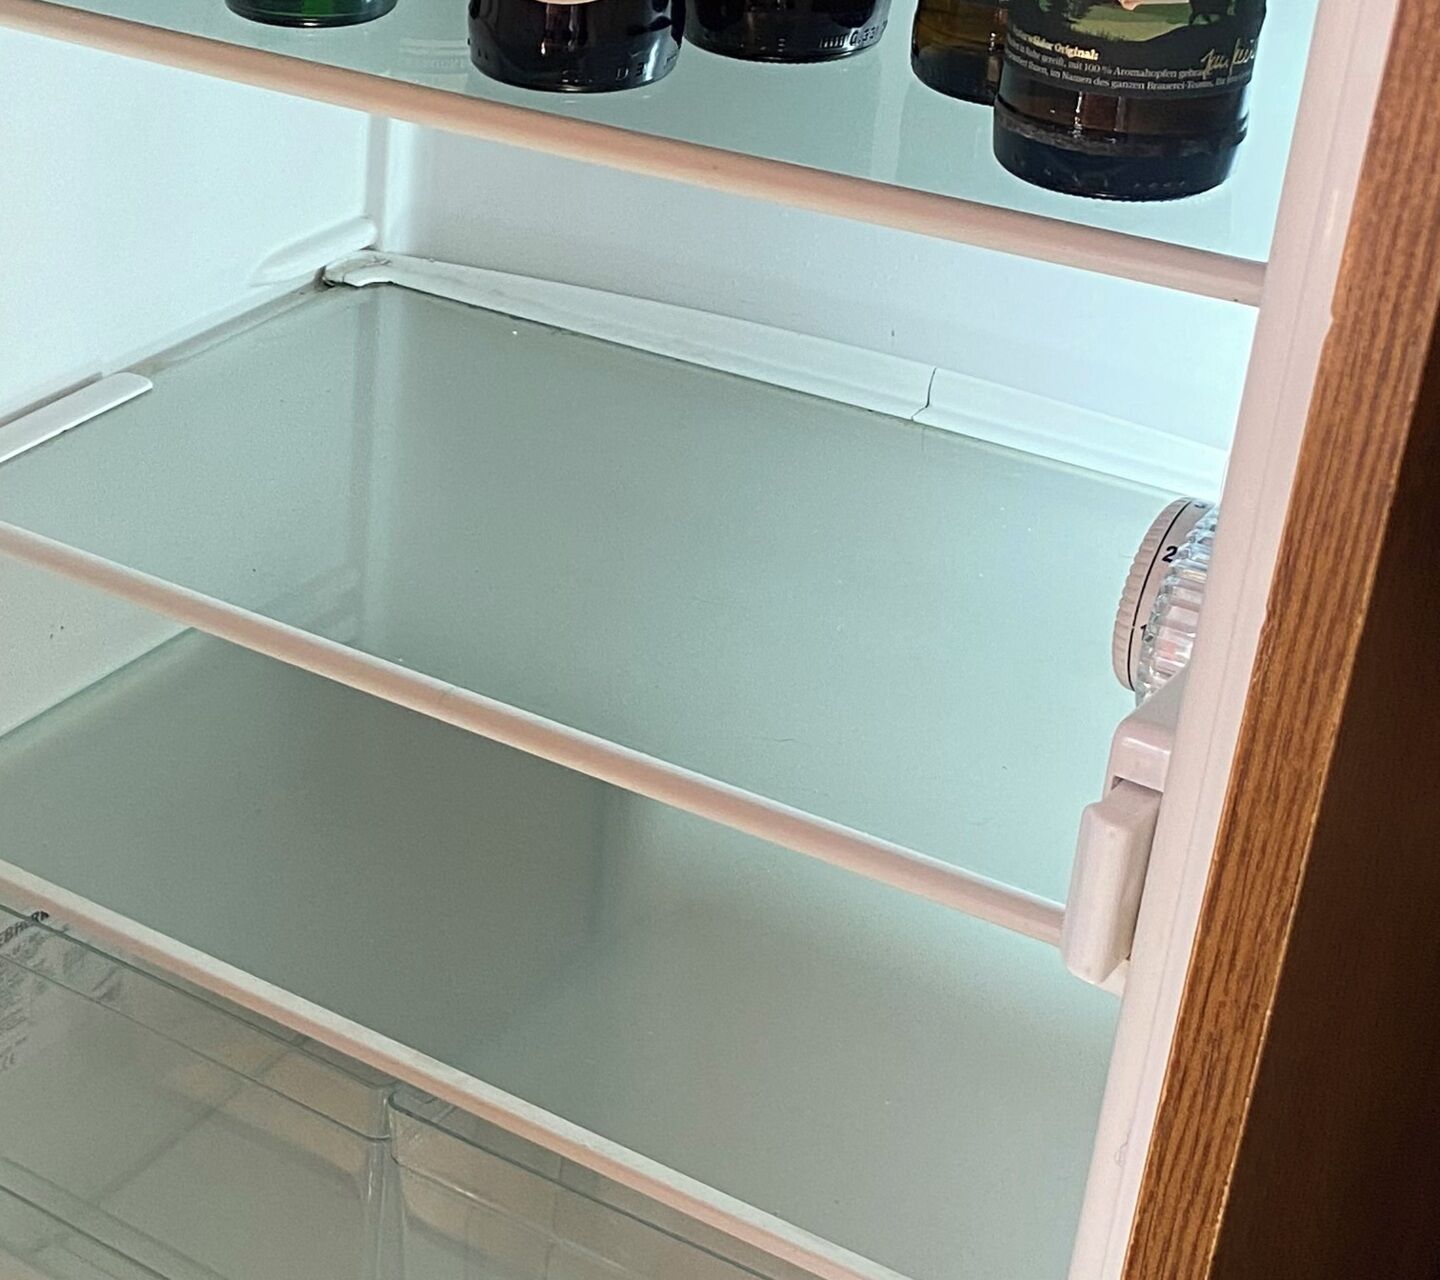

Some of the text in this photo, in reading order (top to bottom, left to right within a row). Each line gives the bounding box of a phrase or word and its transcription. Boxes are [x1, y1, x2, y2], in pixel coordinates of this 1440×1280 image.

[1084, 63, 1101, 73] 100
[1093, 76, 1111, 87] des
[1111, 80, 1145, 92] ganzen
[1162, 545, 1179, 564] 2
